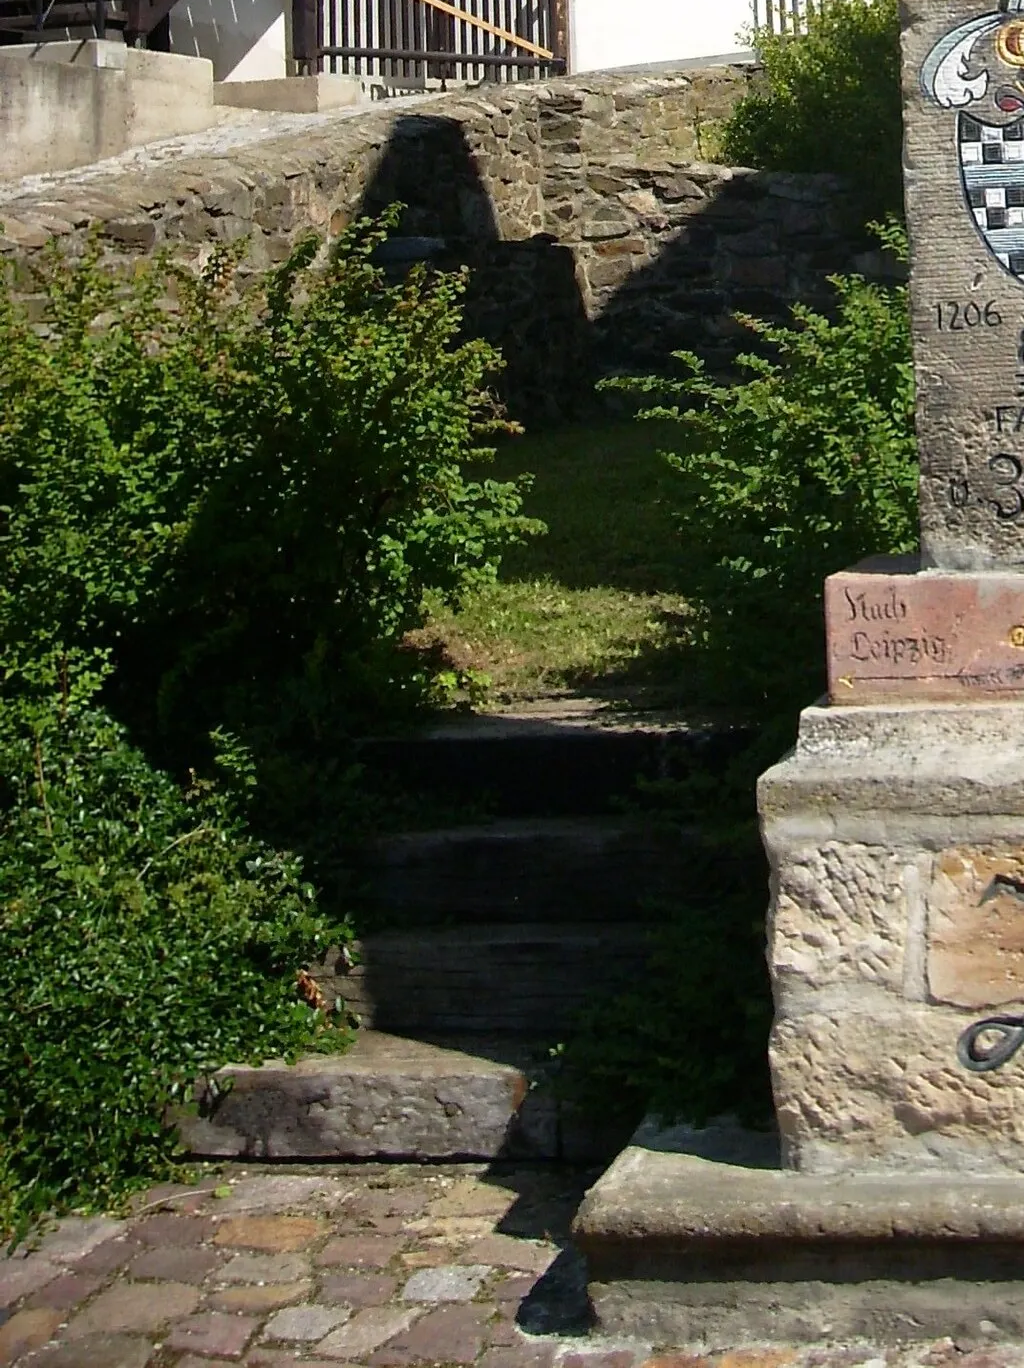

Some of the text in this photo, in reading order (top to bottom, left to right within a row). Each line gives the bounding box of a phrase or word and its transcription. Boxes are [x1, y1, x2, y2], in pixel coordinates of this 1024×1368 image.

[935, 299, 1004, 330] 1206
[844, 586, 907, 622] Nach
[848, 626, 946, 664] Leipzig
